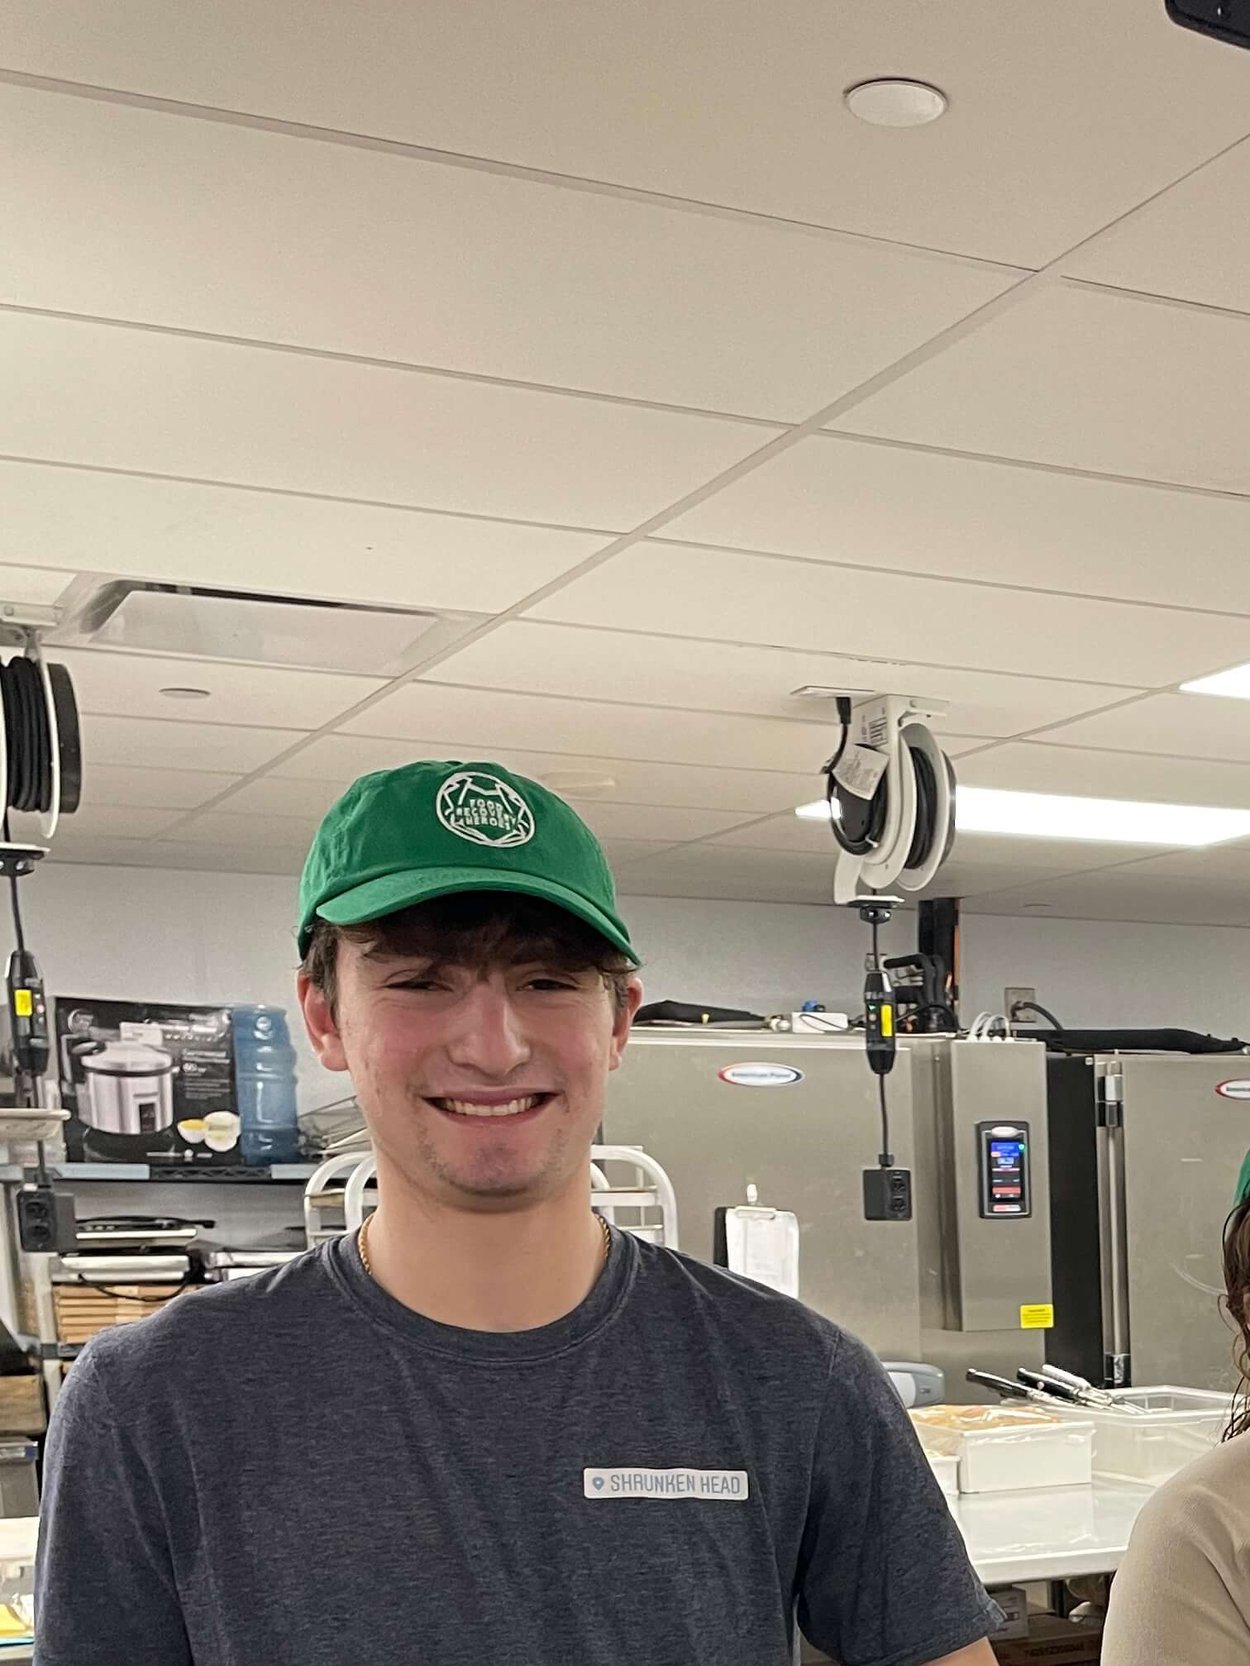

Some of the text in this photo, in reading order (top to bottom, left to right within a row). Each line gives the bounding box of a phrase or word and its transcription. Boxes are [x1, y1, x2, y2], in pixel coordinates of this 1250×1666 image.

[469, 798, 504, 811] FOOD
[610, 1473, 741, 1495] SHRUNKEN HEAD
